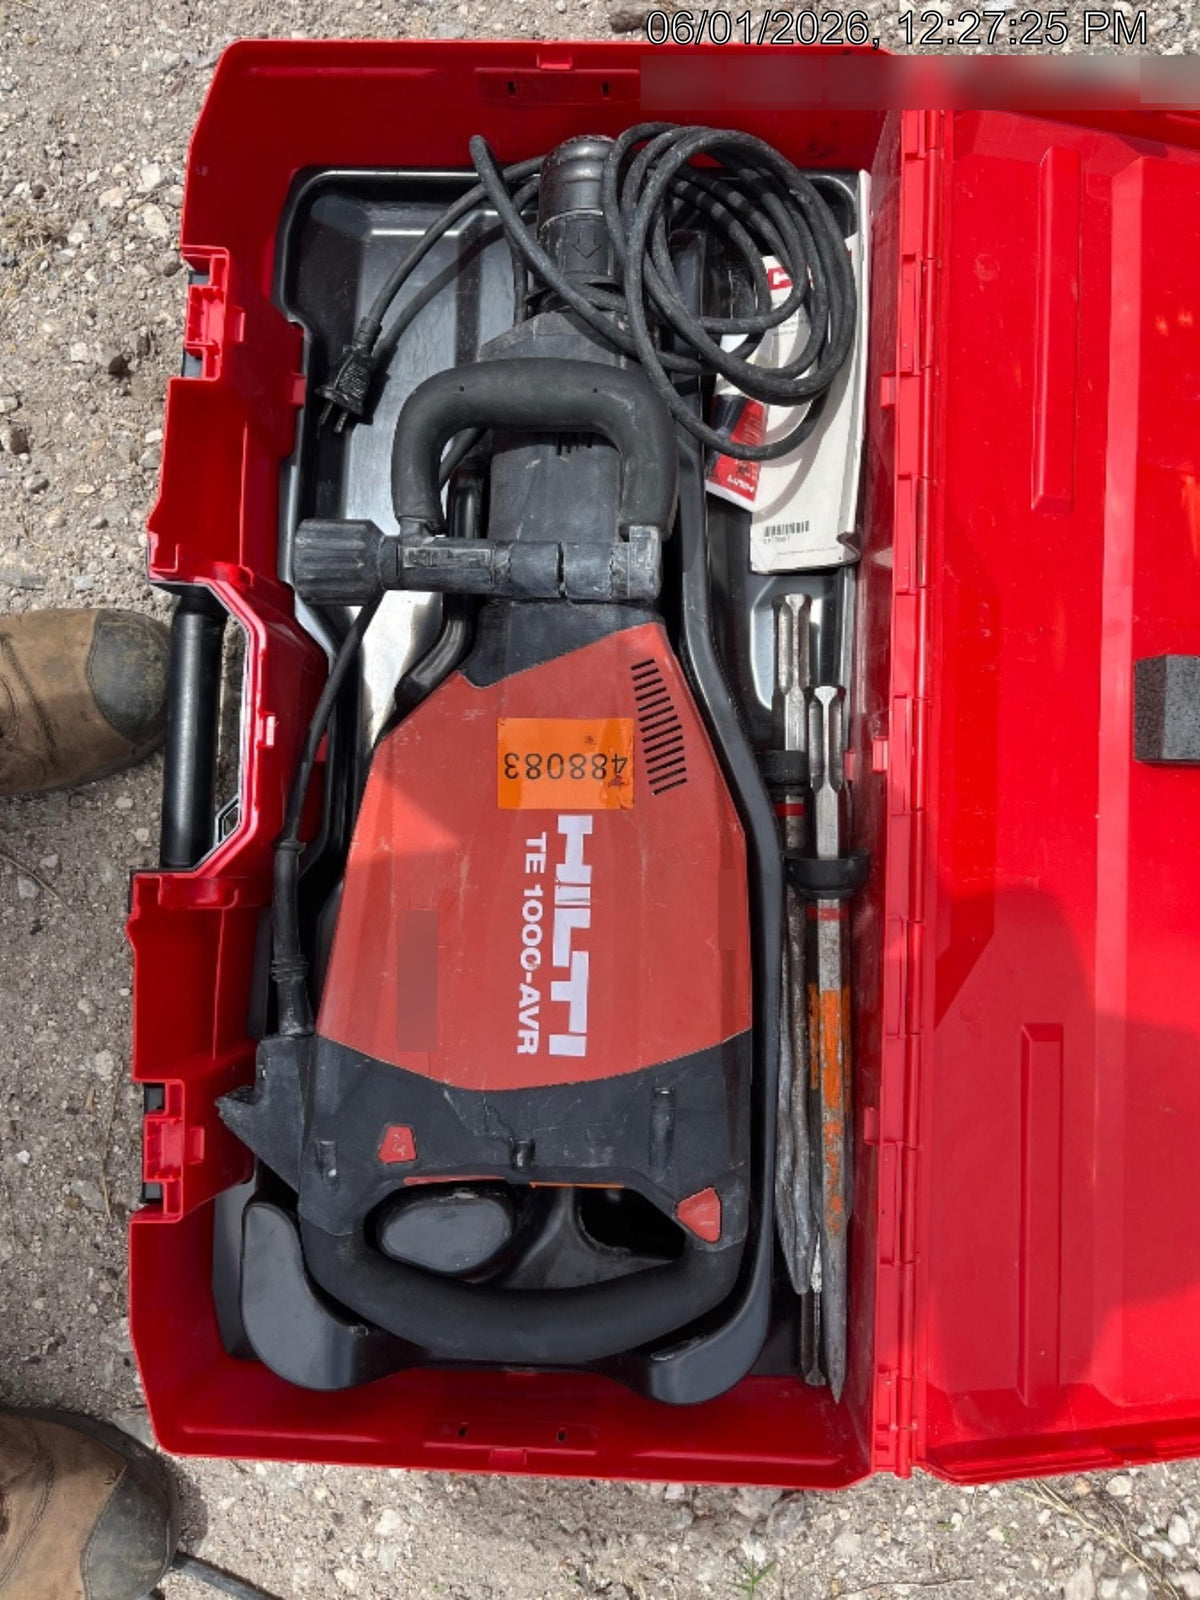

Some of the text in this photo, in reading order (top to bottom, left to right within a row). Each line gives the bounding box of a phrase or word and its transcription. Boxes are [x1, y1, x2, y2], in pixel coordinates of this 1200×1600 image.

[504, 752, 628, 780] 488083
[517, 831, 547, 1055] TE 1000-AVR
[549, 814, 593, 1057] HILTI
